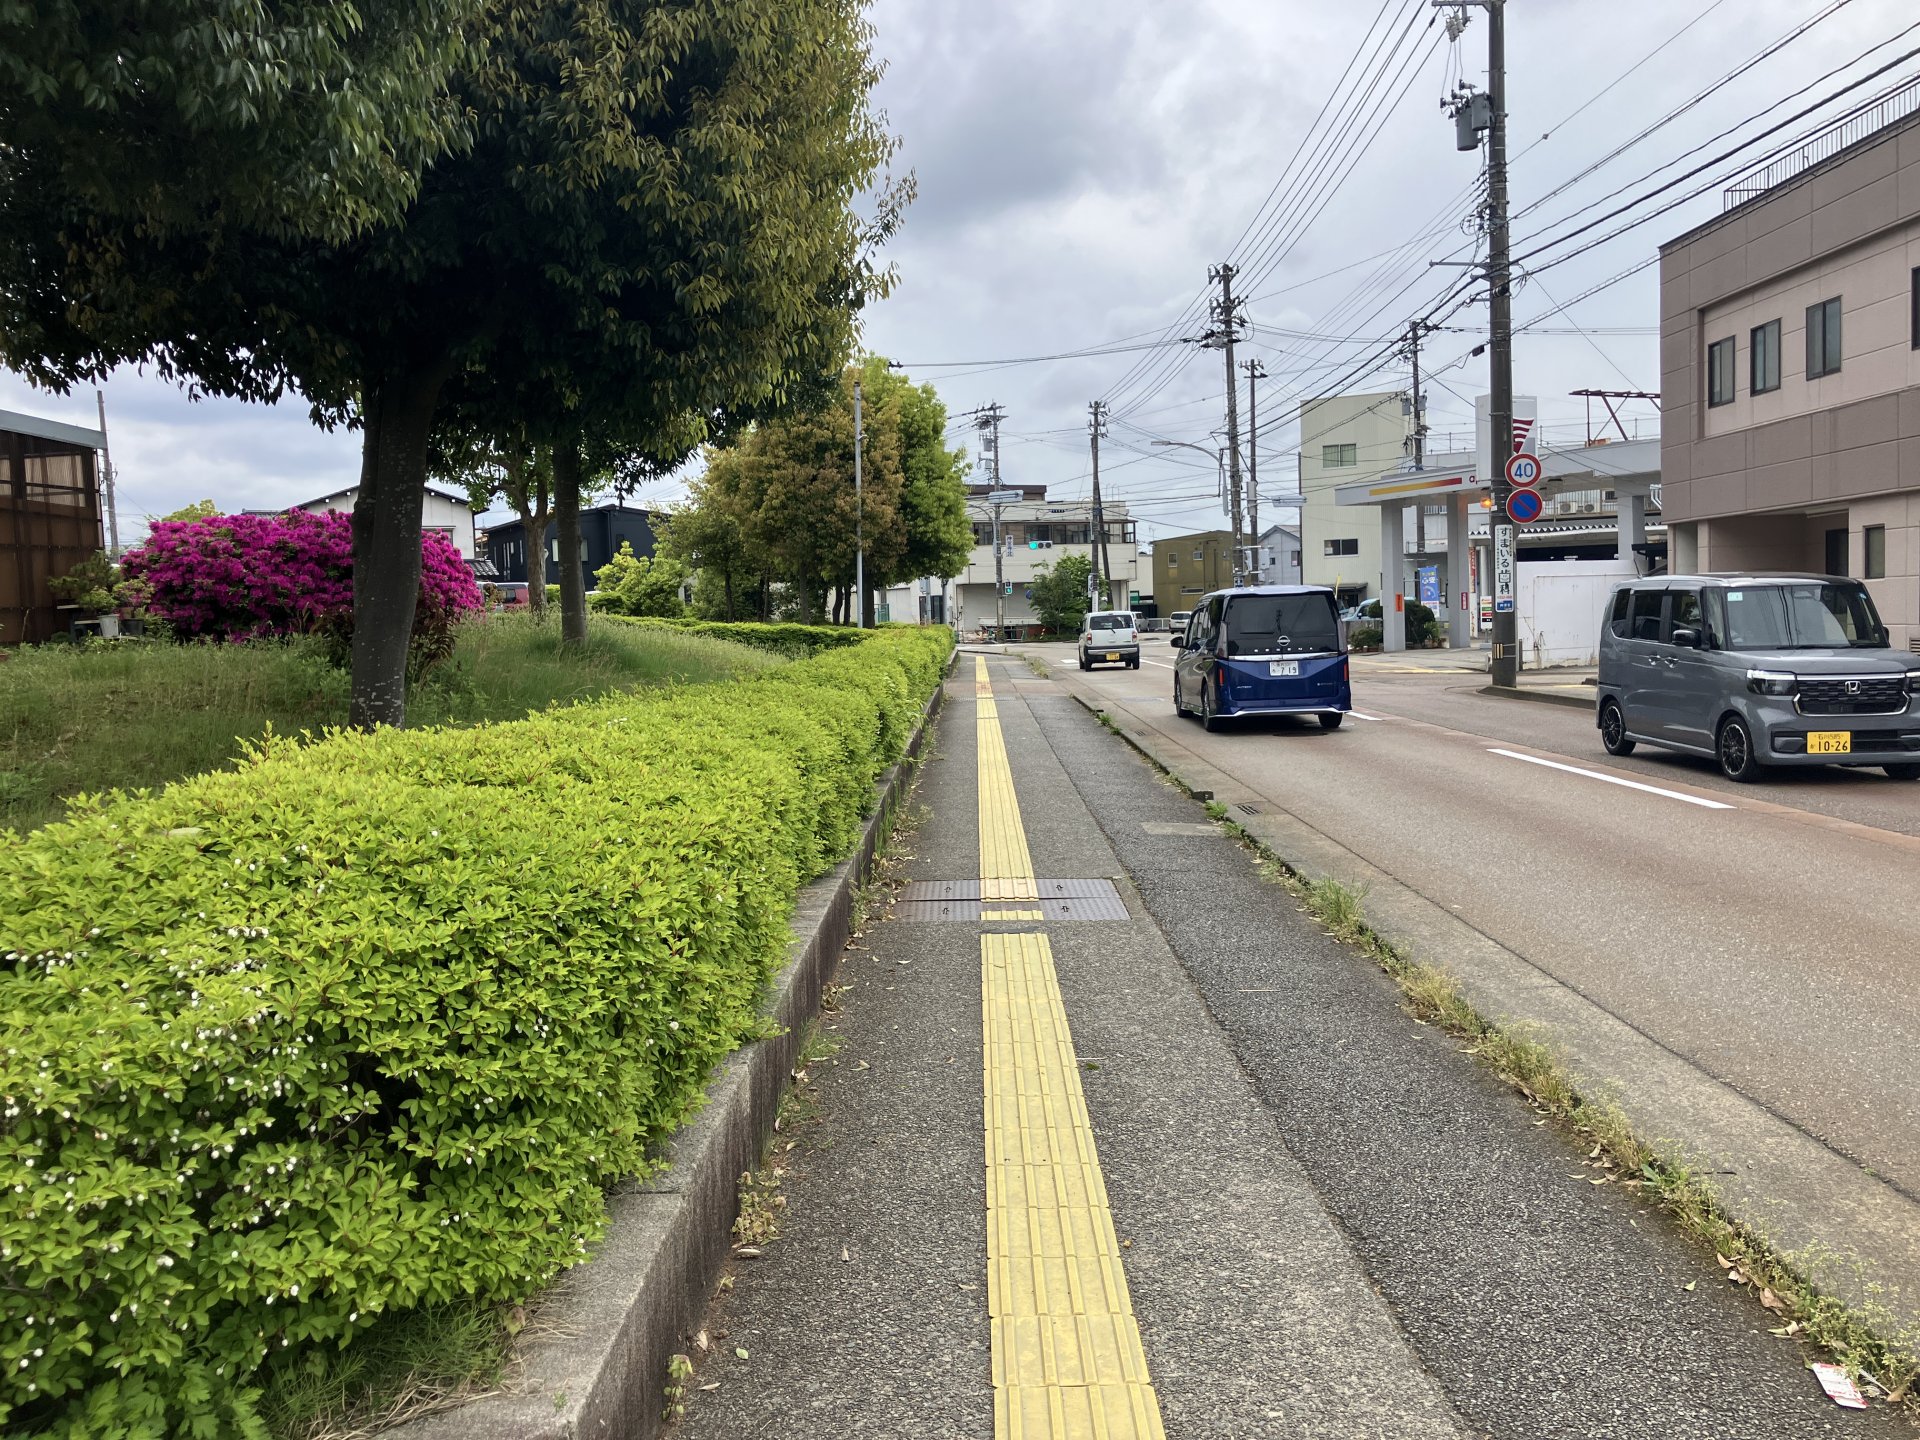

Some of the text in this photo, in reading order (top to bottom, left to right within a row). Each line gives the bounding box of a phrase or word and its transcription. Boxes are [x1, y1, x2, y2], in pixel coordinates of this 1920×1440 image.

[1514, 462, 1534, 478] 40
[1498, 527, 1511, 595] すまいる歯科
[1818, 740, 1848, 752] 10-26
